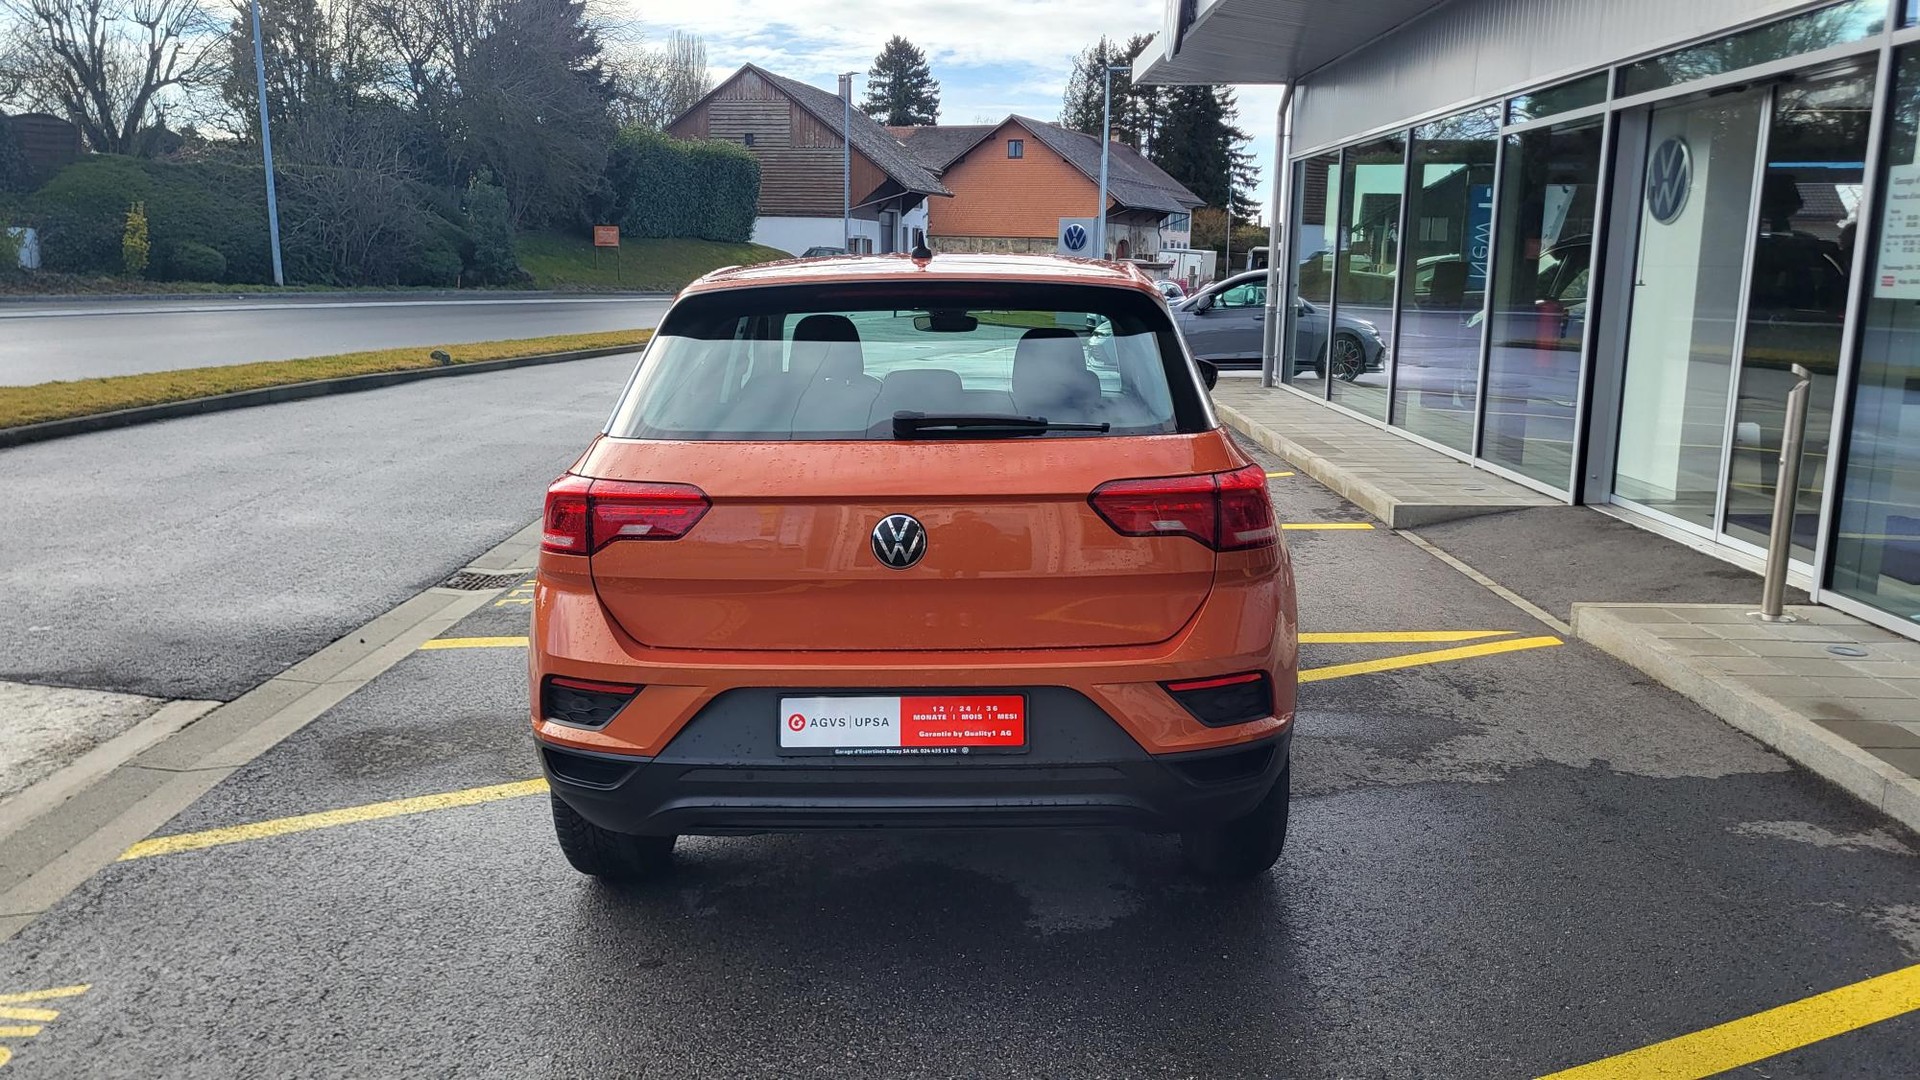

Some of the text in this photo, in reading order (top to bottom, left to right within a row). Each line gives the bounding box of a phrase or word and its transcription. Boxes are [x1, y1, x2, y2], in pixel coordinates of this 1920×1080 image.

[1064, 224, 1087, 252] VW
[872, 514, 927, 569] VW
[810, 717, 890, 727] AGVS UPSA
[953, 730, 963, 738] by
[964, 730, 996, 738] Quality1
